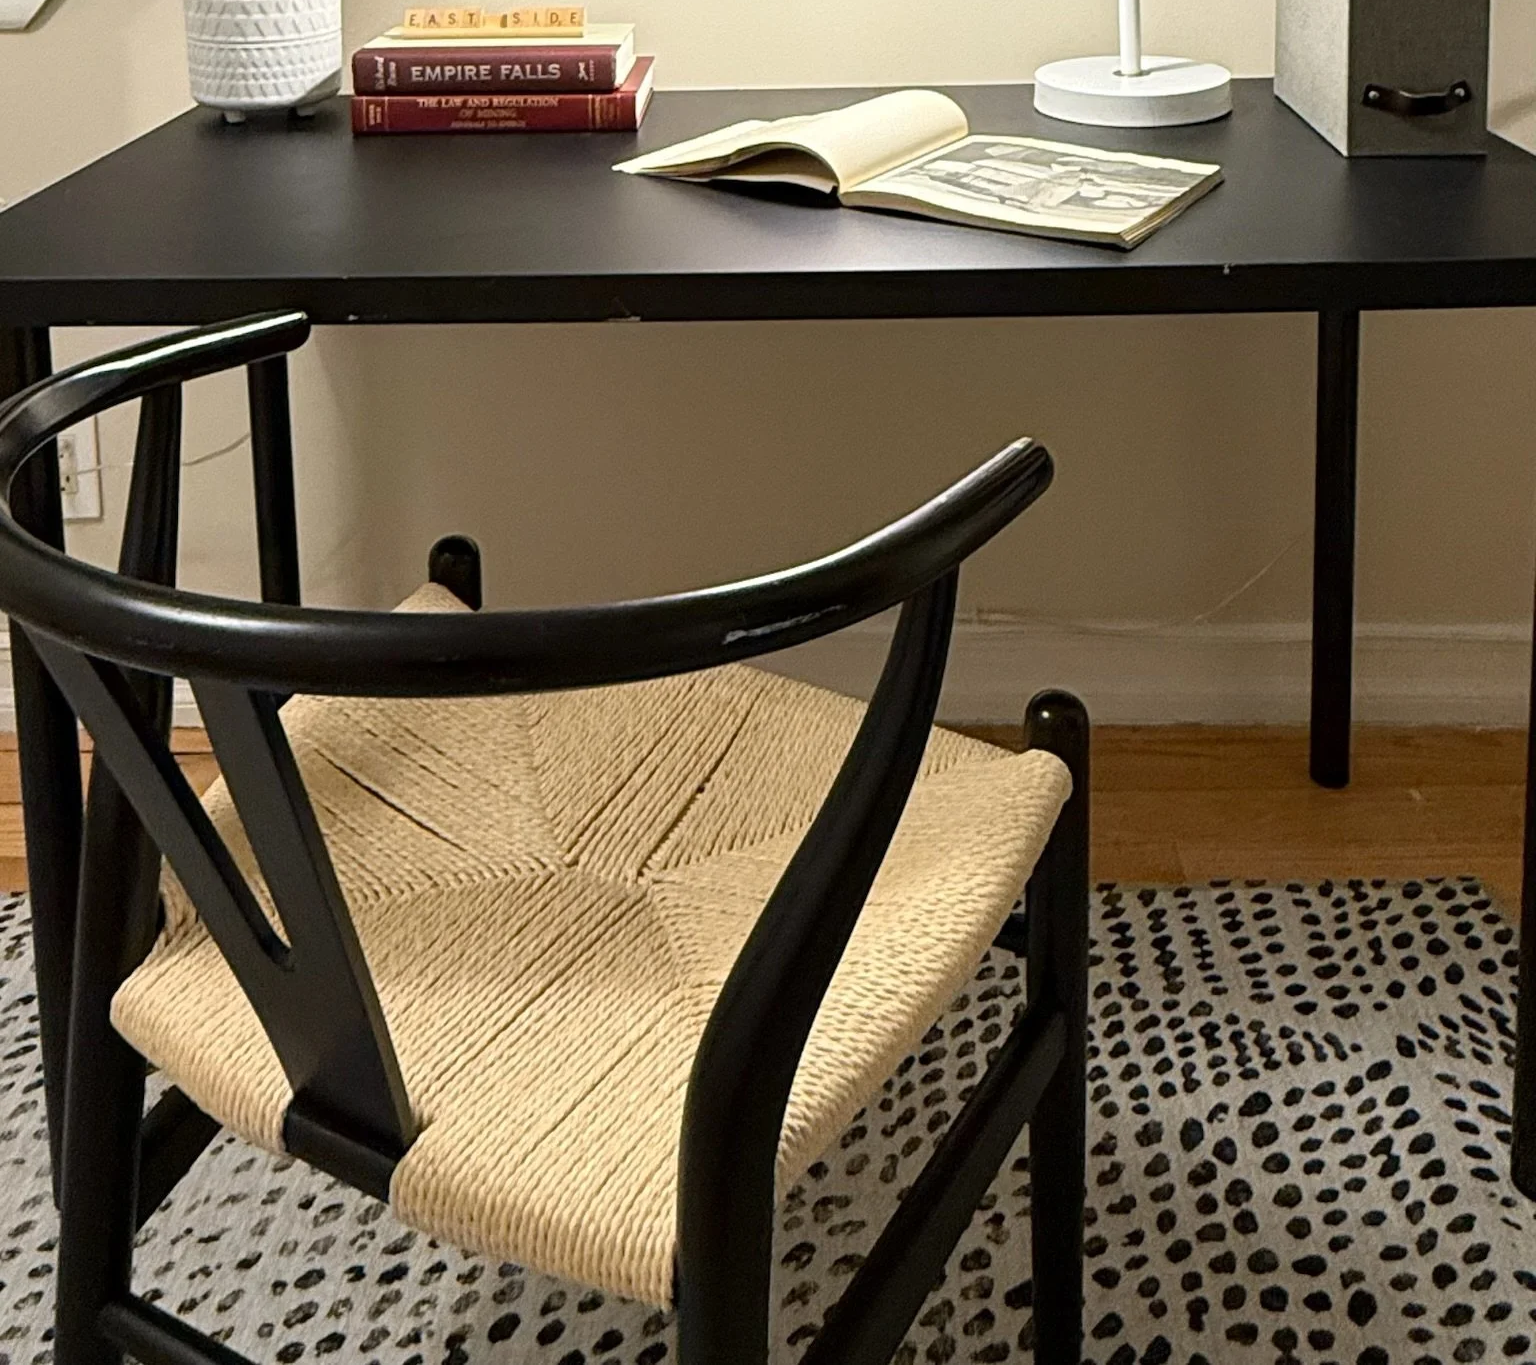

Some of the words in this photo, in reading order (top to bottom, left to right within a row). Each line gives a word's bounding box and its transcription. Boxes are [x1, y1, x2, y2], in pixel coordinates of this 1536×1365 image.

[409, 13, 477, 27] EAST
[513, 12, 578, 26] SIDE
[411, 65, 492, 81] EMPIRE
[500, 63, 561, 80] FALLS
[417, 98, 439, 108] THE
[441, 98, 463, 107] LAW
[466, 98, 490, 107] AND
[492, 97, 559, 107] REGULATION
[459, 109, 473, 118] OF
[477, 108, 517, 118] MINING
